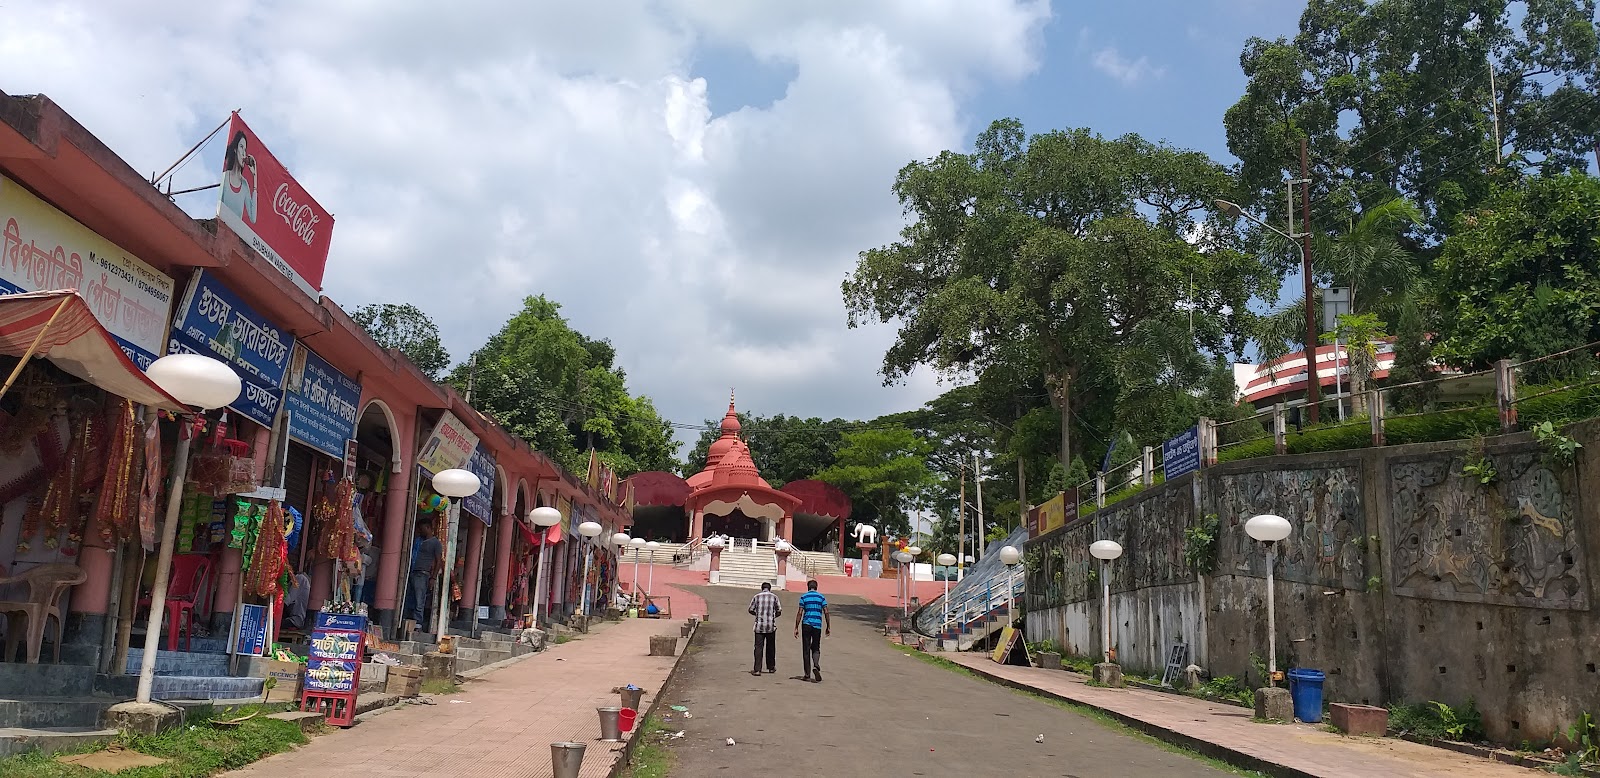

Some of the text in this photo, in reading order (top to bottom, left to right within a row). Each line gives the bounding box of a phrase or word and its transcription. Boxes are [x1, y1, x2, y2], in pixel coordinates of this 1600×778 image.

[89, 251, 96, 263] M
[252, 236, 294, 282] SHUBHAM VARIETIES
[198, 286, 232, 330] শুভম
[304, 377, 311, 398] মা
[246, 381, 278, 413] ভান্ডার
[338, 640, 359, 652] পান
[270, 671, 298, 679] DECENCY
[334, 671, 355, 681] পান
